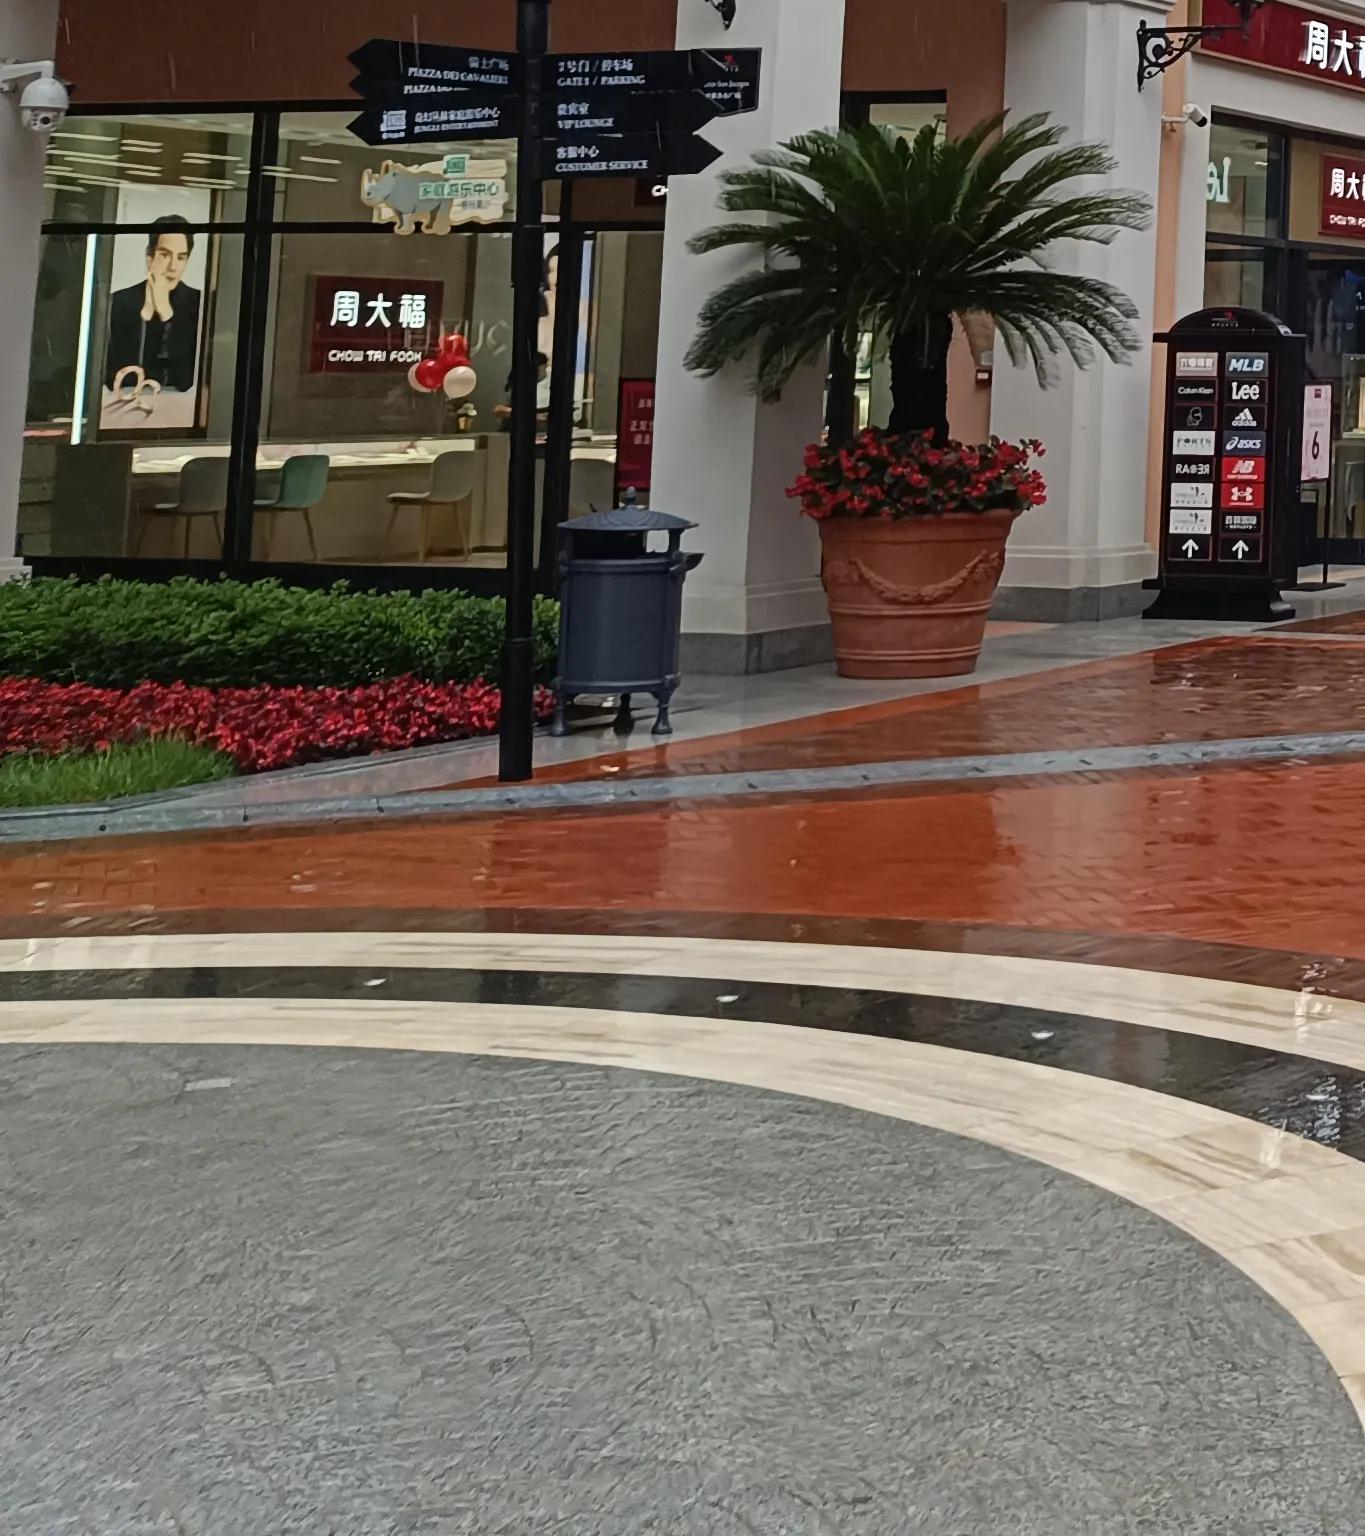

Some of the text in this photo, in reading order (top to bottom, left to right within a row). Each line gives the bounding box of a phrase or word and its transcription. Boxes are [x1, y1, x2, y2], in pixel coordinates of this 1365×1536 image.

[407, 67, 441, 80] PIAZZA
[329, 290, 426, 328] 周大福
[328, 349, 422, 362] CHOW TAI FOOK
[1229, 359, 1264, 371] MLB
[1231, 381, 1260, 400] Lee
[1311, 430, 1320, 460] 6
